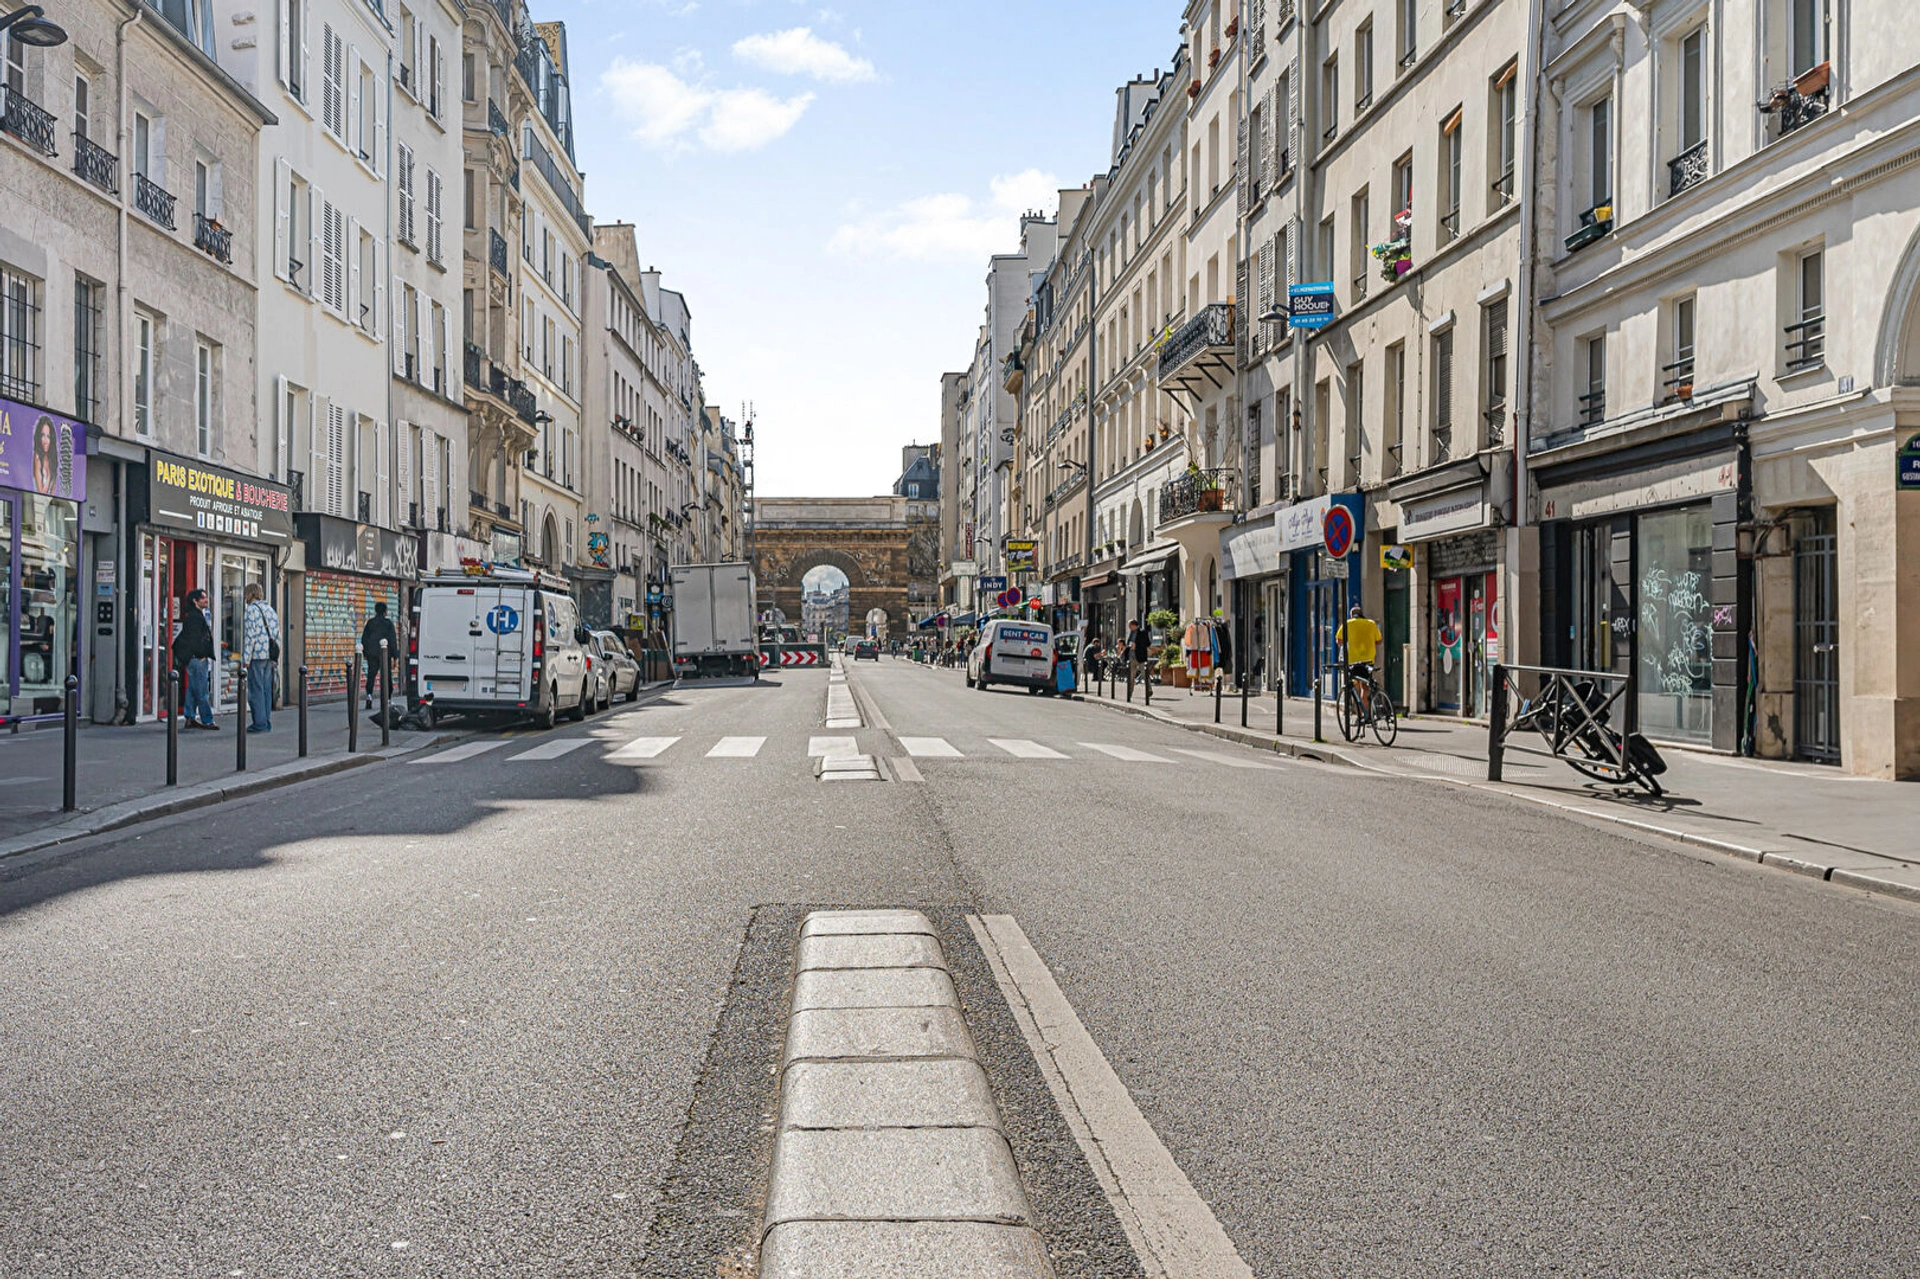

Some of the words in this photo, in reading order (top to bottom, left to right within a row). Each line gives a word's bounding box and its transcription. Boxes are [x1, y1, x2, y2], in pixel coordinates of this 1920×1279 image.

[1294, 295, 1313, 304] GUY
[157, 460, 187, 489] PARIS
[188, 468, 235, 500] EXOTIQUE
[236, 481, 242, 501] &
[243, 483, 288, 512] BOUCHERIE
[190, 495, 210, 511] PRODUIT
[212, 500, 233, 515] AFRIQUE
[234, 505, 240, 516] ET
[241, 507, 263, 521] ASIATIQUE
[1545, 501, 1555, 517] 41
[1003, 629, 1021, 638] RENT
[1029, 632, 1044, 640] CAR
